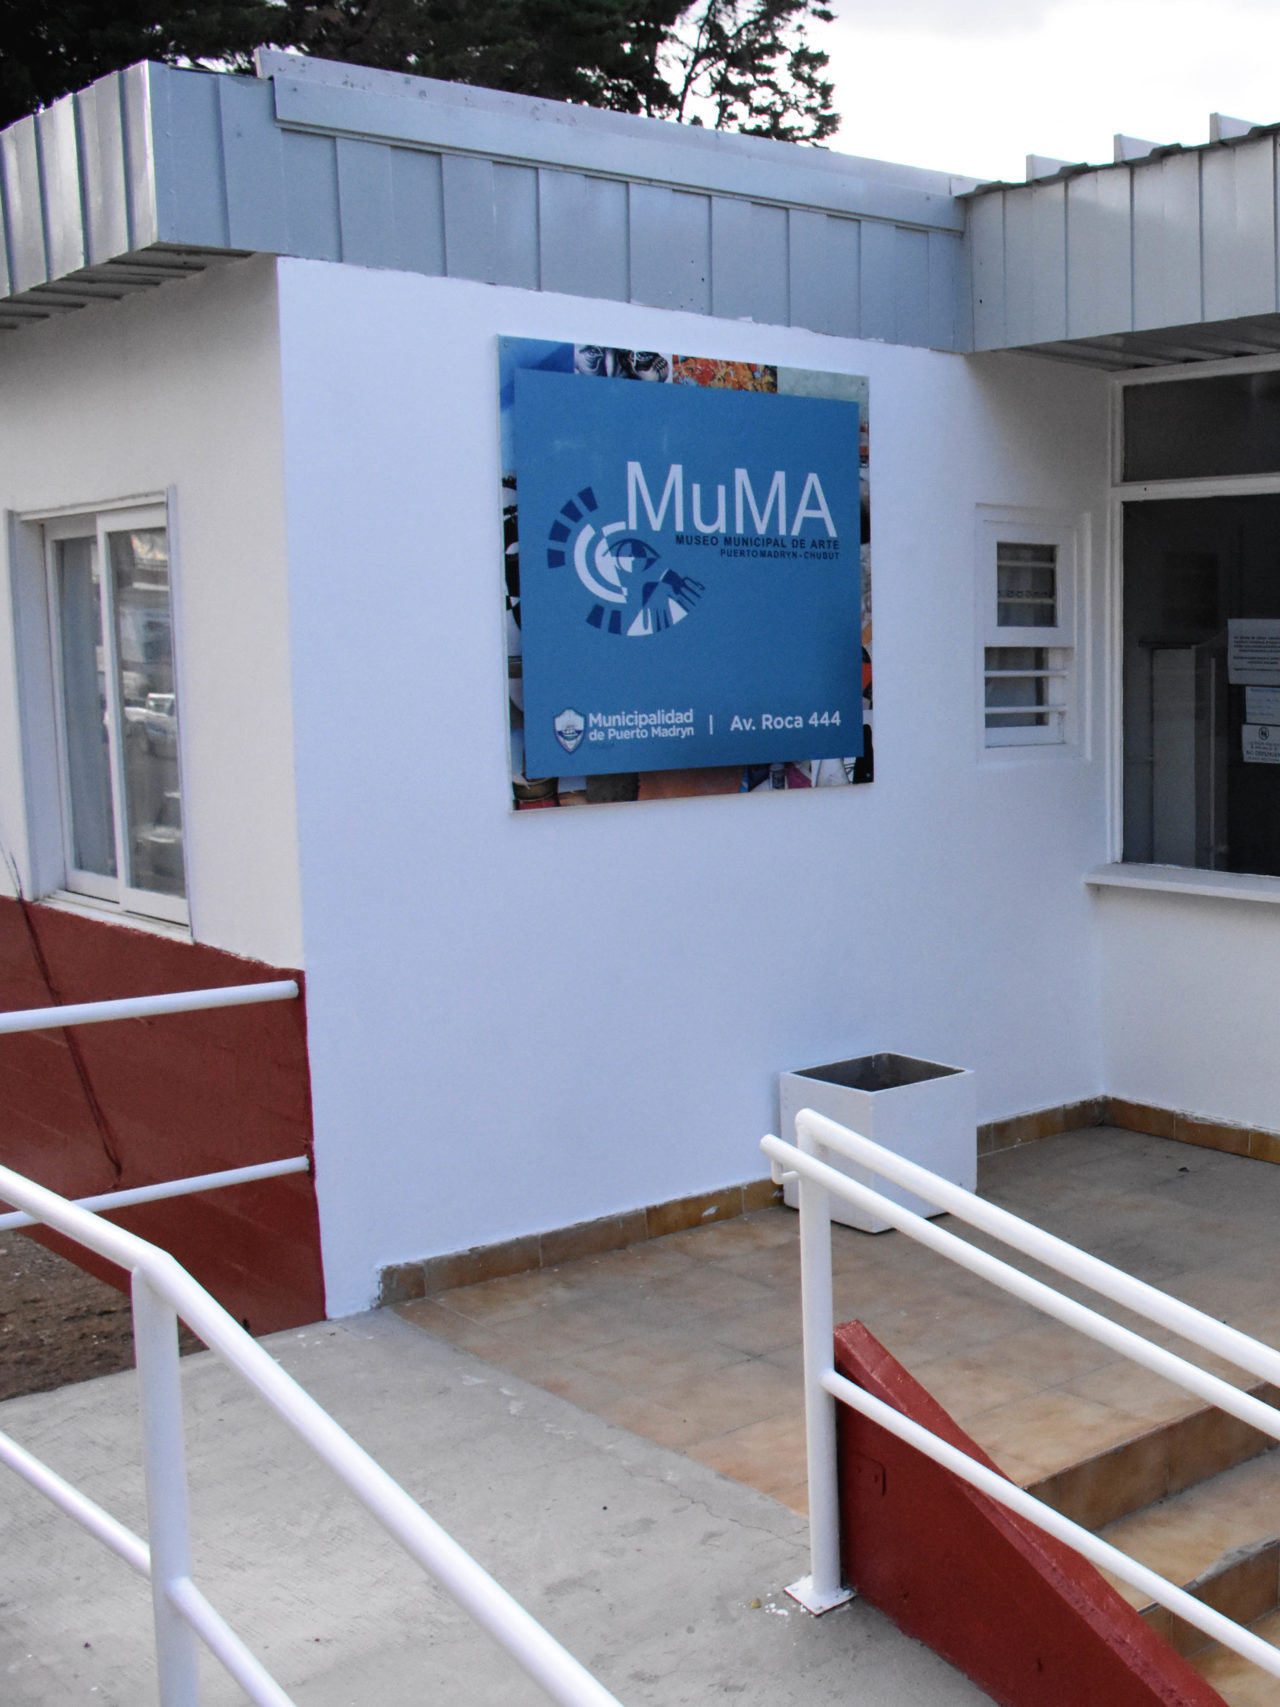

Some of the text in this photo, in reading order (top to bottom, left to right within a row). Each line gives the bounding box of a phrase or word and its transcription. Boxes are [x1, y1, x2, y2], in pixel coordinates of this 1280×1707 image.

[627, 461, 838, 537] MuMA
[675, 535, 839, 549] MUSEO MUNICIPAL DE ARTE
[720, 549, 758, 558] PUERTO
[588, 708, 694, 729] Municipalidad
[730, 711, 841, 731] Av. Roca 444
[588, 726, 694, 741] de Puerto Madryn
